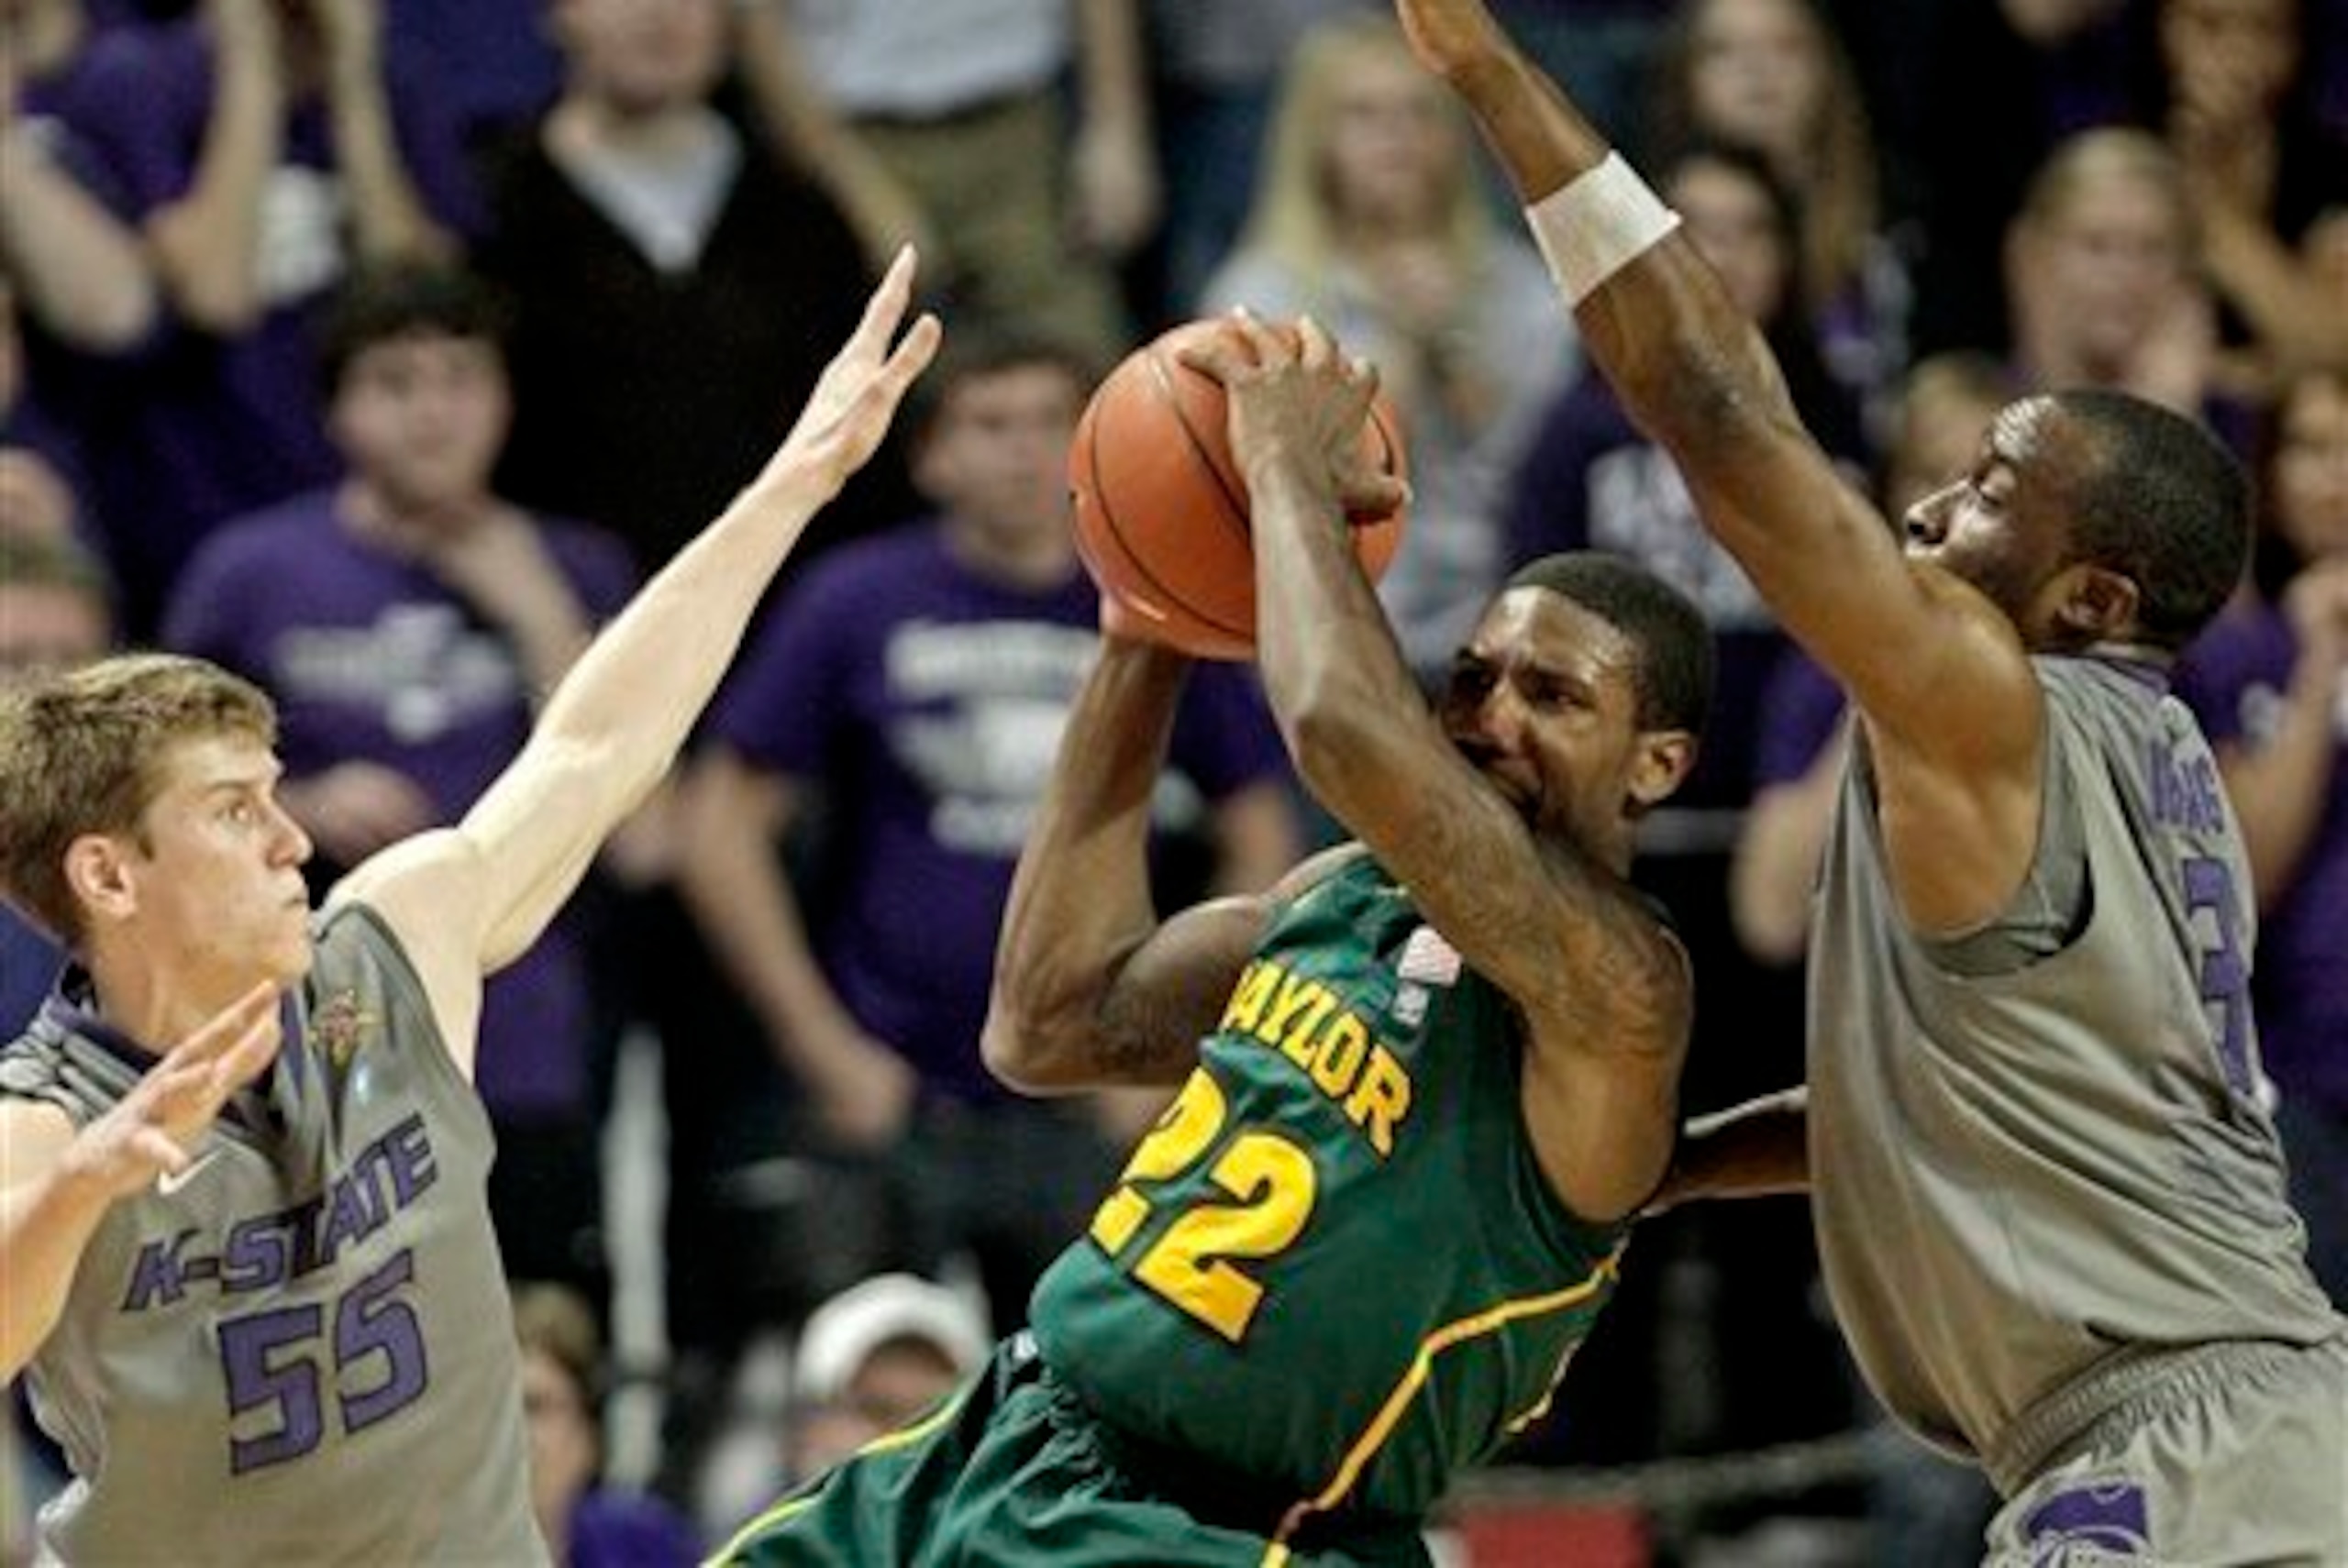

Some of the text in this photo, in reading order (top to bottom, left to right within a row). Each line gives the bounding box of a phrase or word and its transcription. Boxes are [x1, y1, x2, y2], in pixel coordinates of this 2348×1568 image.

[1221, 960, 1412, 1157] AYLOR
[122, 1112, 439, 1312] K-STATE
[1090, 1067, 1316, 1342] 22
[217, 1249, 427, 1475] 55
